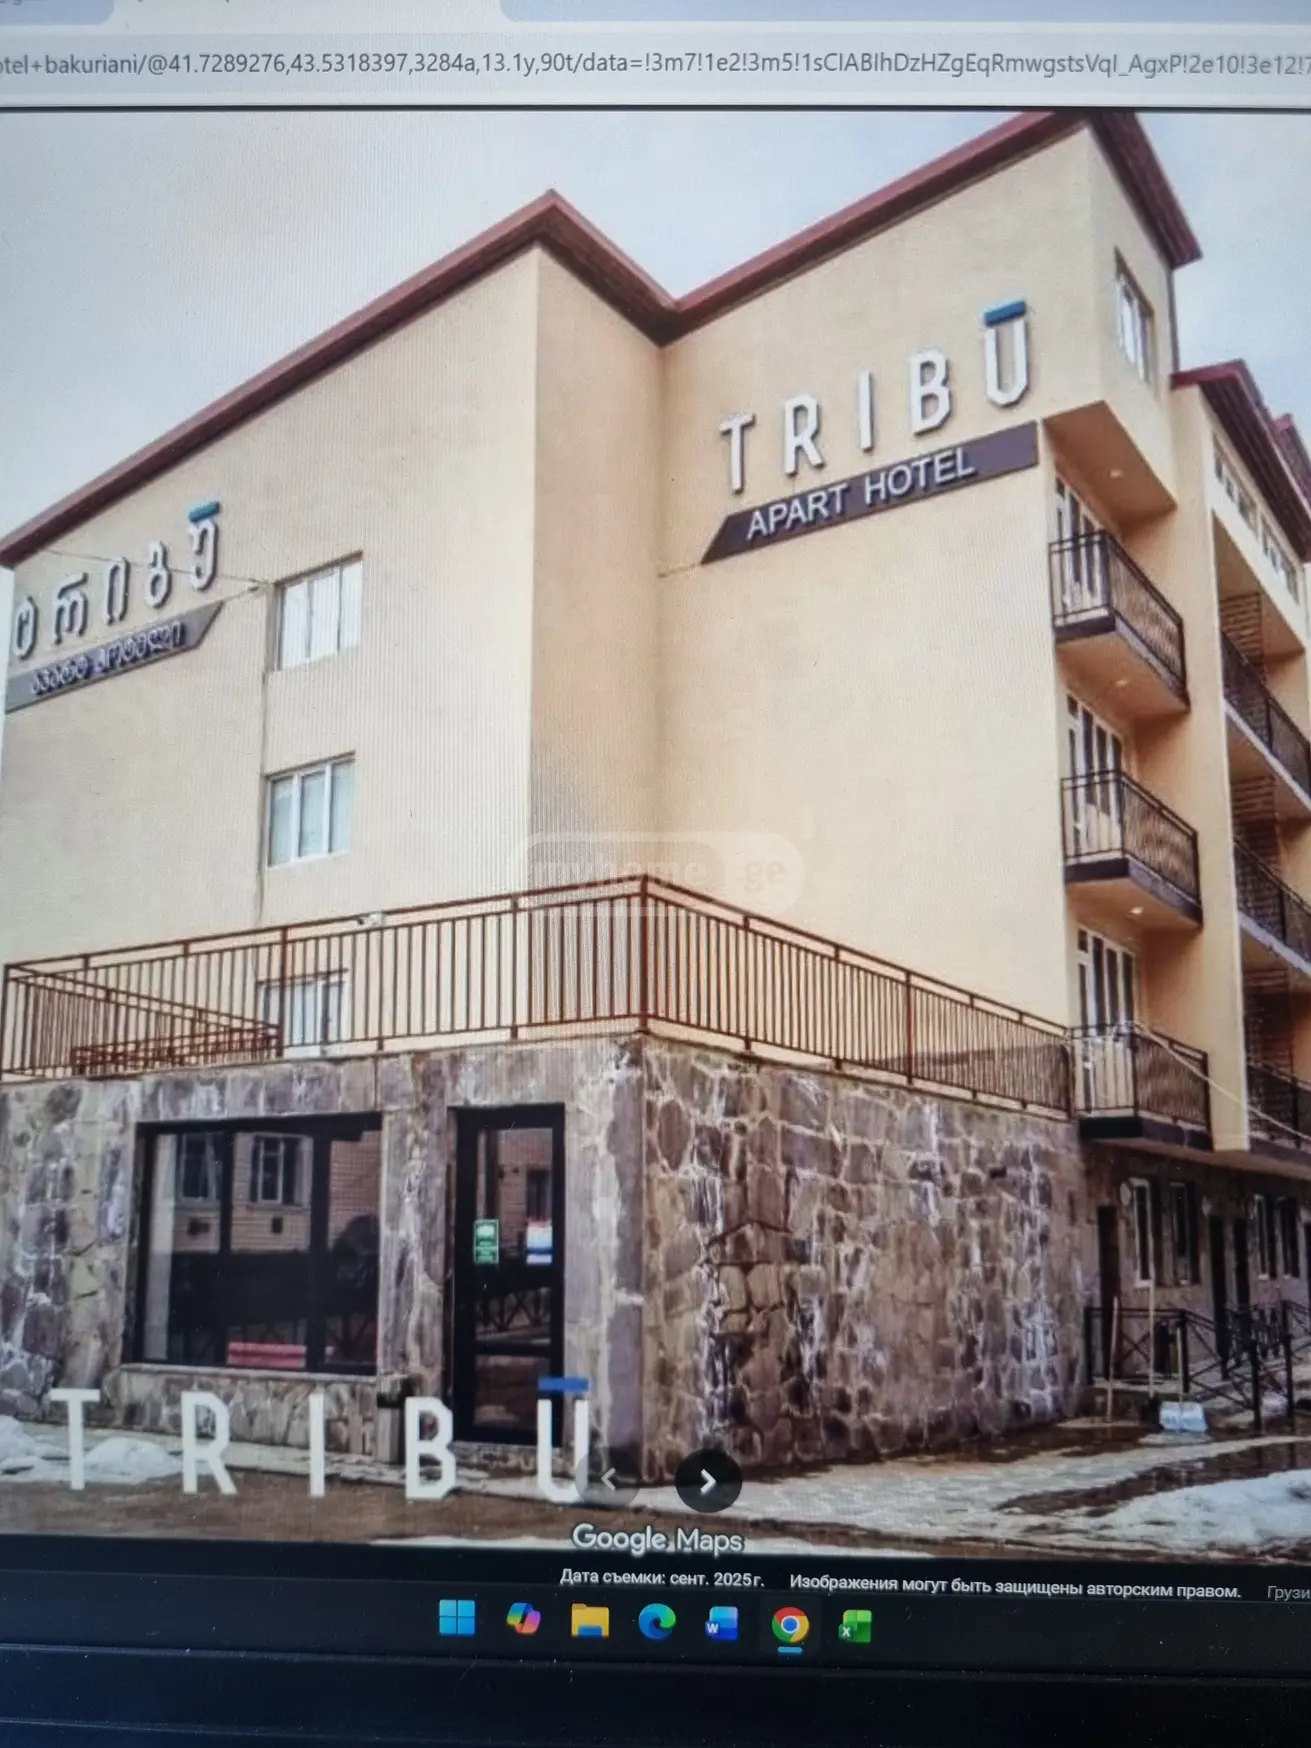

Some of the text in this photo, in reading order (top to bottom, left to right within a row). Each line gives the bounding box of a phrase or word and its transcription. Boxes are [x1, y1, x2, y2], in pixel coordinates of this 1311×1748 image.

[747, 447, 975, 541] APART HOTEL
[572, 1522, 744, 1557] Google Maps
[560, 1568, 599, 1585] Дата
[602, 1571, 666, 1586] съемки:
[670, 1573, 709, 1586] сент.
[790, 1574, 1242, 1600] Изображения могут быть защищены авторским правом.
[706, 1622, 720, 1634] W
[842, 1626, 851, 1637] X
